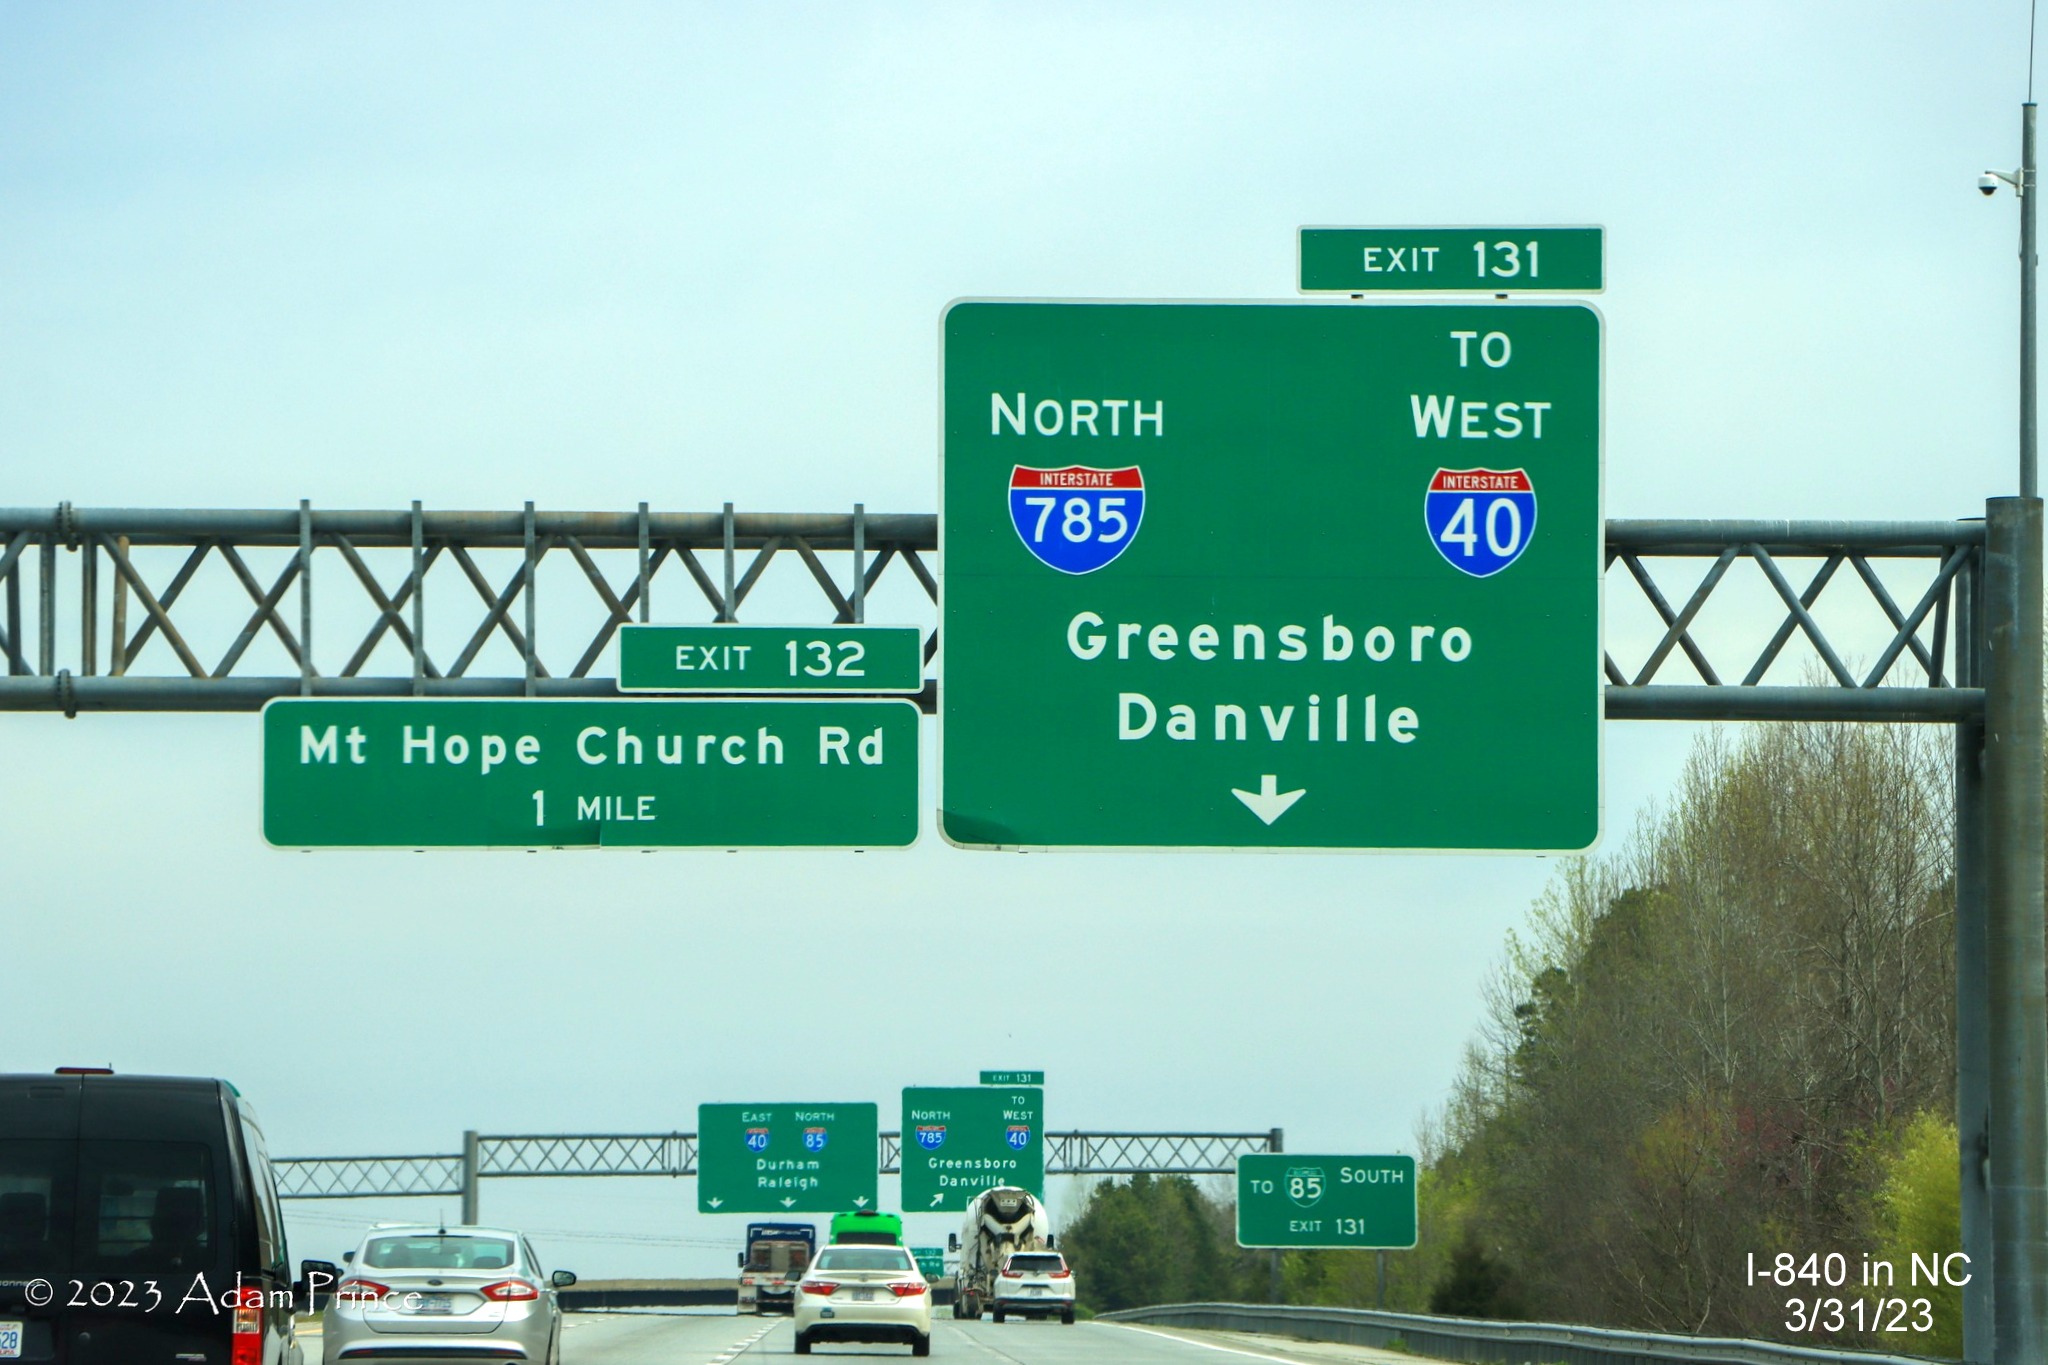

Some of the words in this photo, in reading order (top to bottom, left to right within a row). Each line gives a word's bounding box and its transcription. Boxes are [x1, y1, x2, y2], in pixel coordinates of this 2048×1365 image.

[1364, 247, 1439, 271] EXIT
[1474, 241, 1537, 277] 131
[1451, 331, 1511, 367] TO
[992, 393, 1162, 435] NORTH
[1411, 395, 1551, 438] WEST
[1041, 471, 1114, 486] INTERSTATE
[1443, 476, 1518, 488] INTERSTATE
[1024, 497, 1127, 544] 785
[1441, 500, 1521, 556] 40
[1068, 612, 1471, 661] Greensboro
[677, 646, 751, 670] EXIT
[786, 641, 864, 676] 132
[1119, 693, 1418, 743] Danville
[301, 726, 365, 763] Mt
[404, 726, 540, 774] Hope
[577, 726, 783, 764] Church
[820, 727, 882, 764] Rd
[533, 790, 543, 826] 1
[578, 796, 655, 820] MILE
[992, 1075, 1011, 1083] EXIT
[1016, 1074, 1033, 1084] 131
[1012, 1096, 1024, 1104] TO
[742, 1112, 771, 1122] EAST
[796, 1112, 834, 1121] NORTH
[912, 1110, 950, 1120] NORTH
[1004, 1111, 1032, 1120] WEST
[748, 1135, 767, 1148] 40
[806, 1134, 825, 1148] 85
[920, 1132, 942, 1143] 785
[1010, 1132, 1027, 1146] 40
[757, 1158, 819, 1170] Durham
[929, 1158, 1016, 1168] Greensboro
[758, 1177, 817, 1190] Raleigh
[940, 1175, 1006, 1187] Danville
[1251, 1180, 1273, 1193] TO
[1290, 1178, 1321, 1198] 85
[1341, 1167, 1403, 1183] SOUTH
[1290, 1221, 1321, 1231] EXIT
[1337, 1219, 1364, 1234] 131
